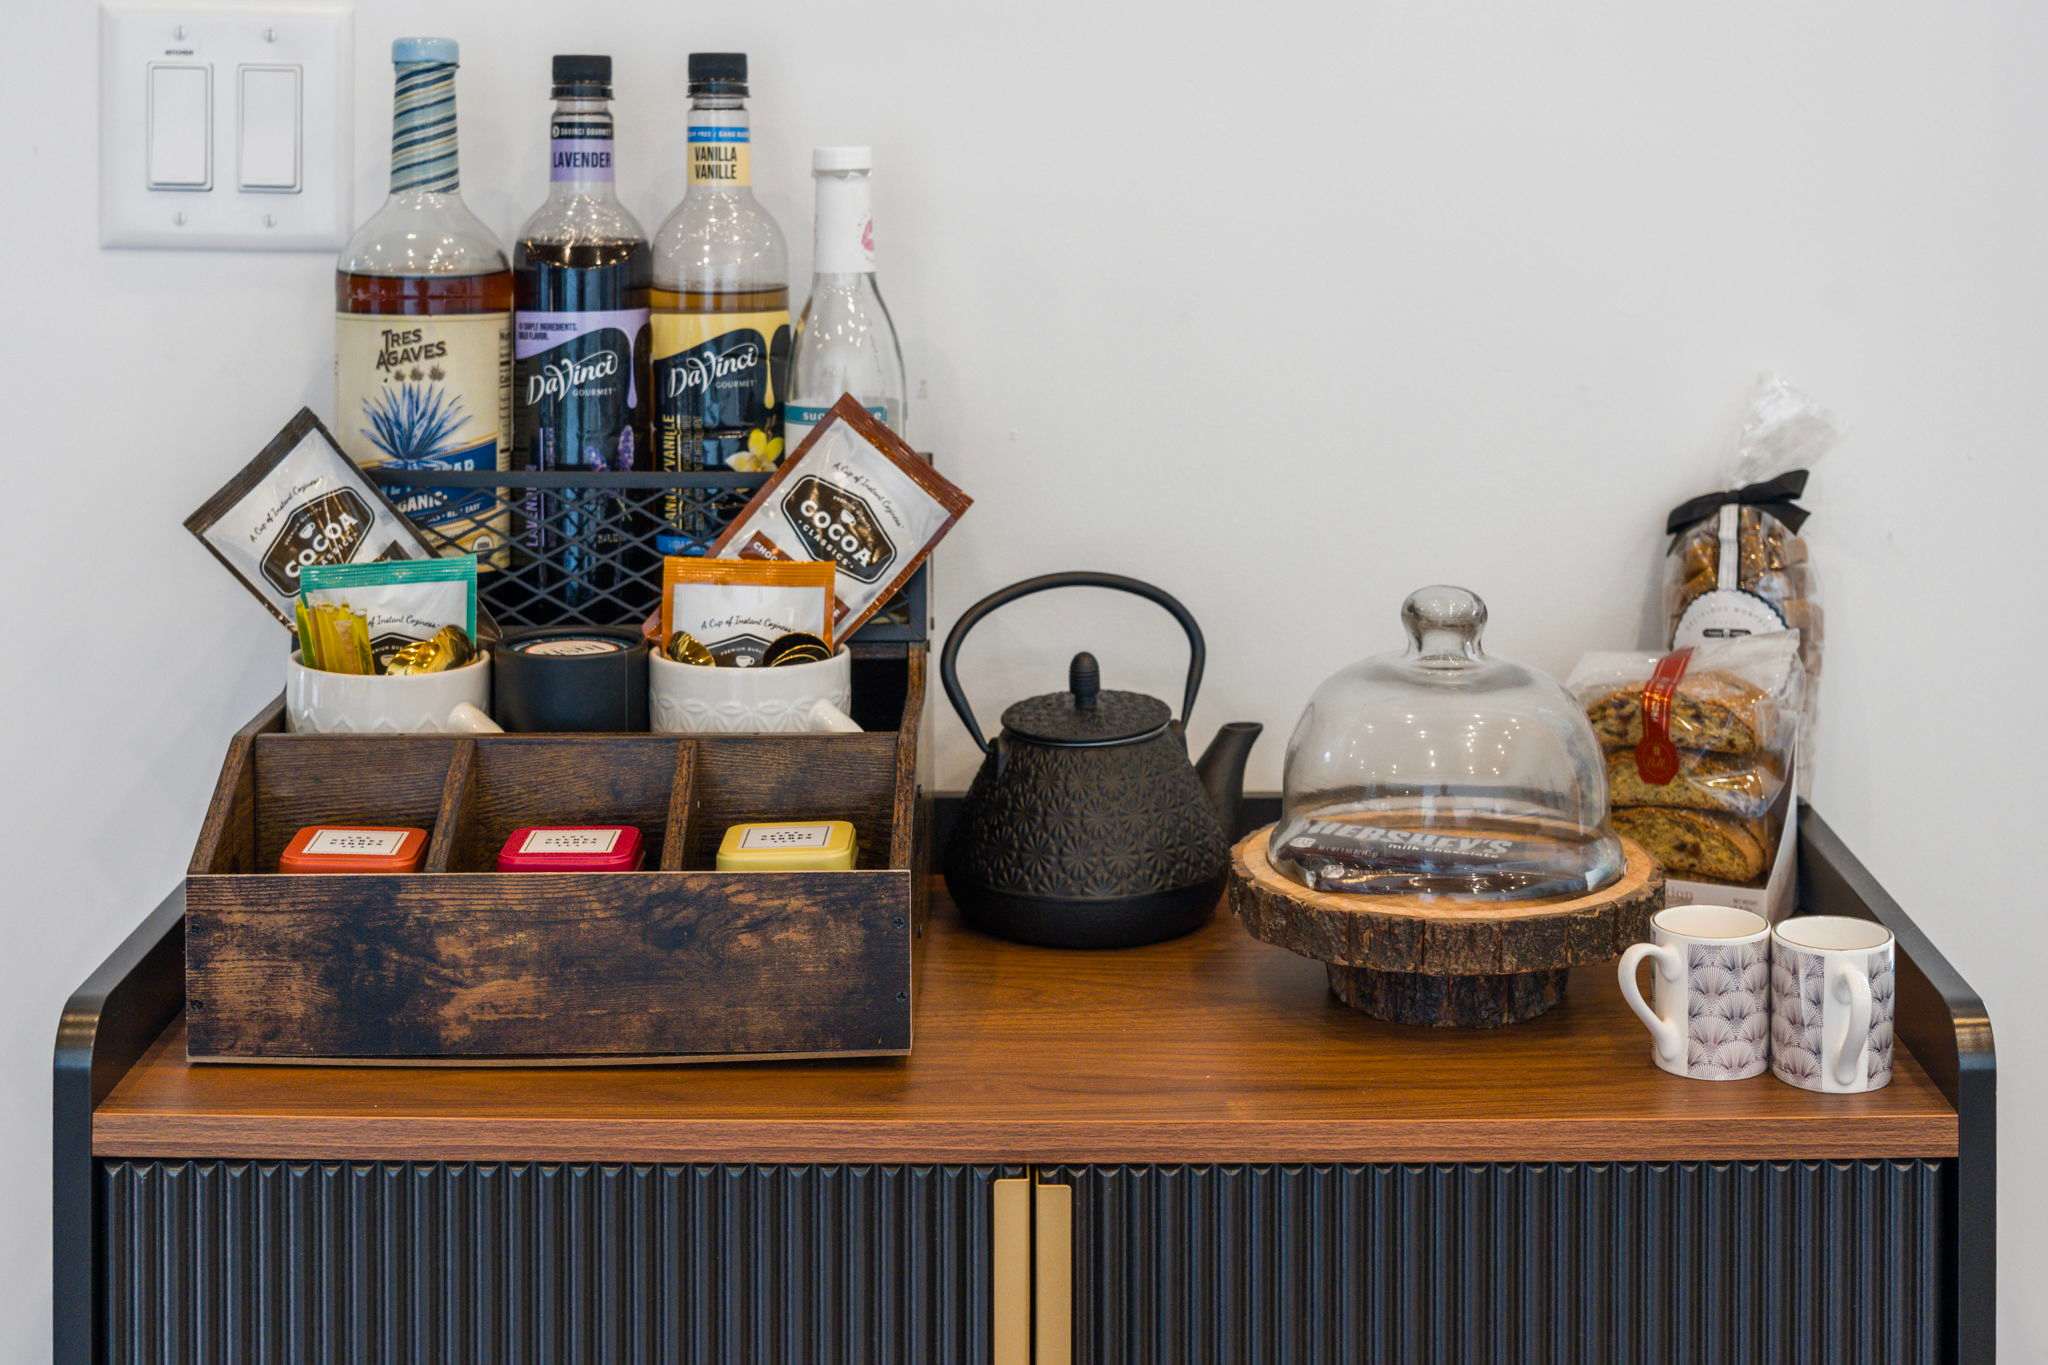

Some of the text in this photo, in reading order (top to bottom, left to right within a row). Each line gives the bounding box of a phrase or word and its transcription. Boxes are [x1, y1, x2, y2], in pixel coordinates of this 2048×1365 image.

[553, 152, 611, 168] LAVENDER
[694, 146, 737, 161] VANILLA
[694, 164, 737, 179] VANILLE
[382, 328, 422, 352] TRES
[376, 341, 448, 372] AGAVES
[527, 350, 618, 406] DaVinci
[668, 342, 759, 398] DaVinci
[572, 387, 613, 398] GOURMET
[715, 379, 754, 390] GOURMET
[800, 500, 871, 567] COCOA
[285, 512, 358, 577] COCOA
[709, 618, 723, 629] Cup
[735, 615, 762, 625] Instant
